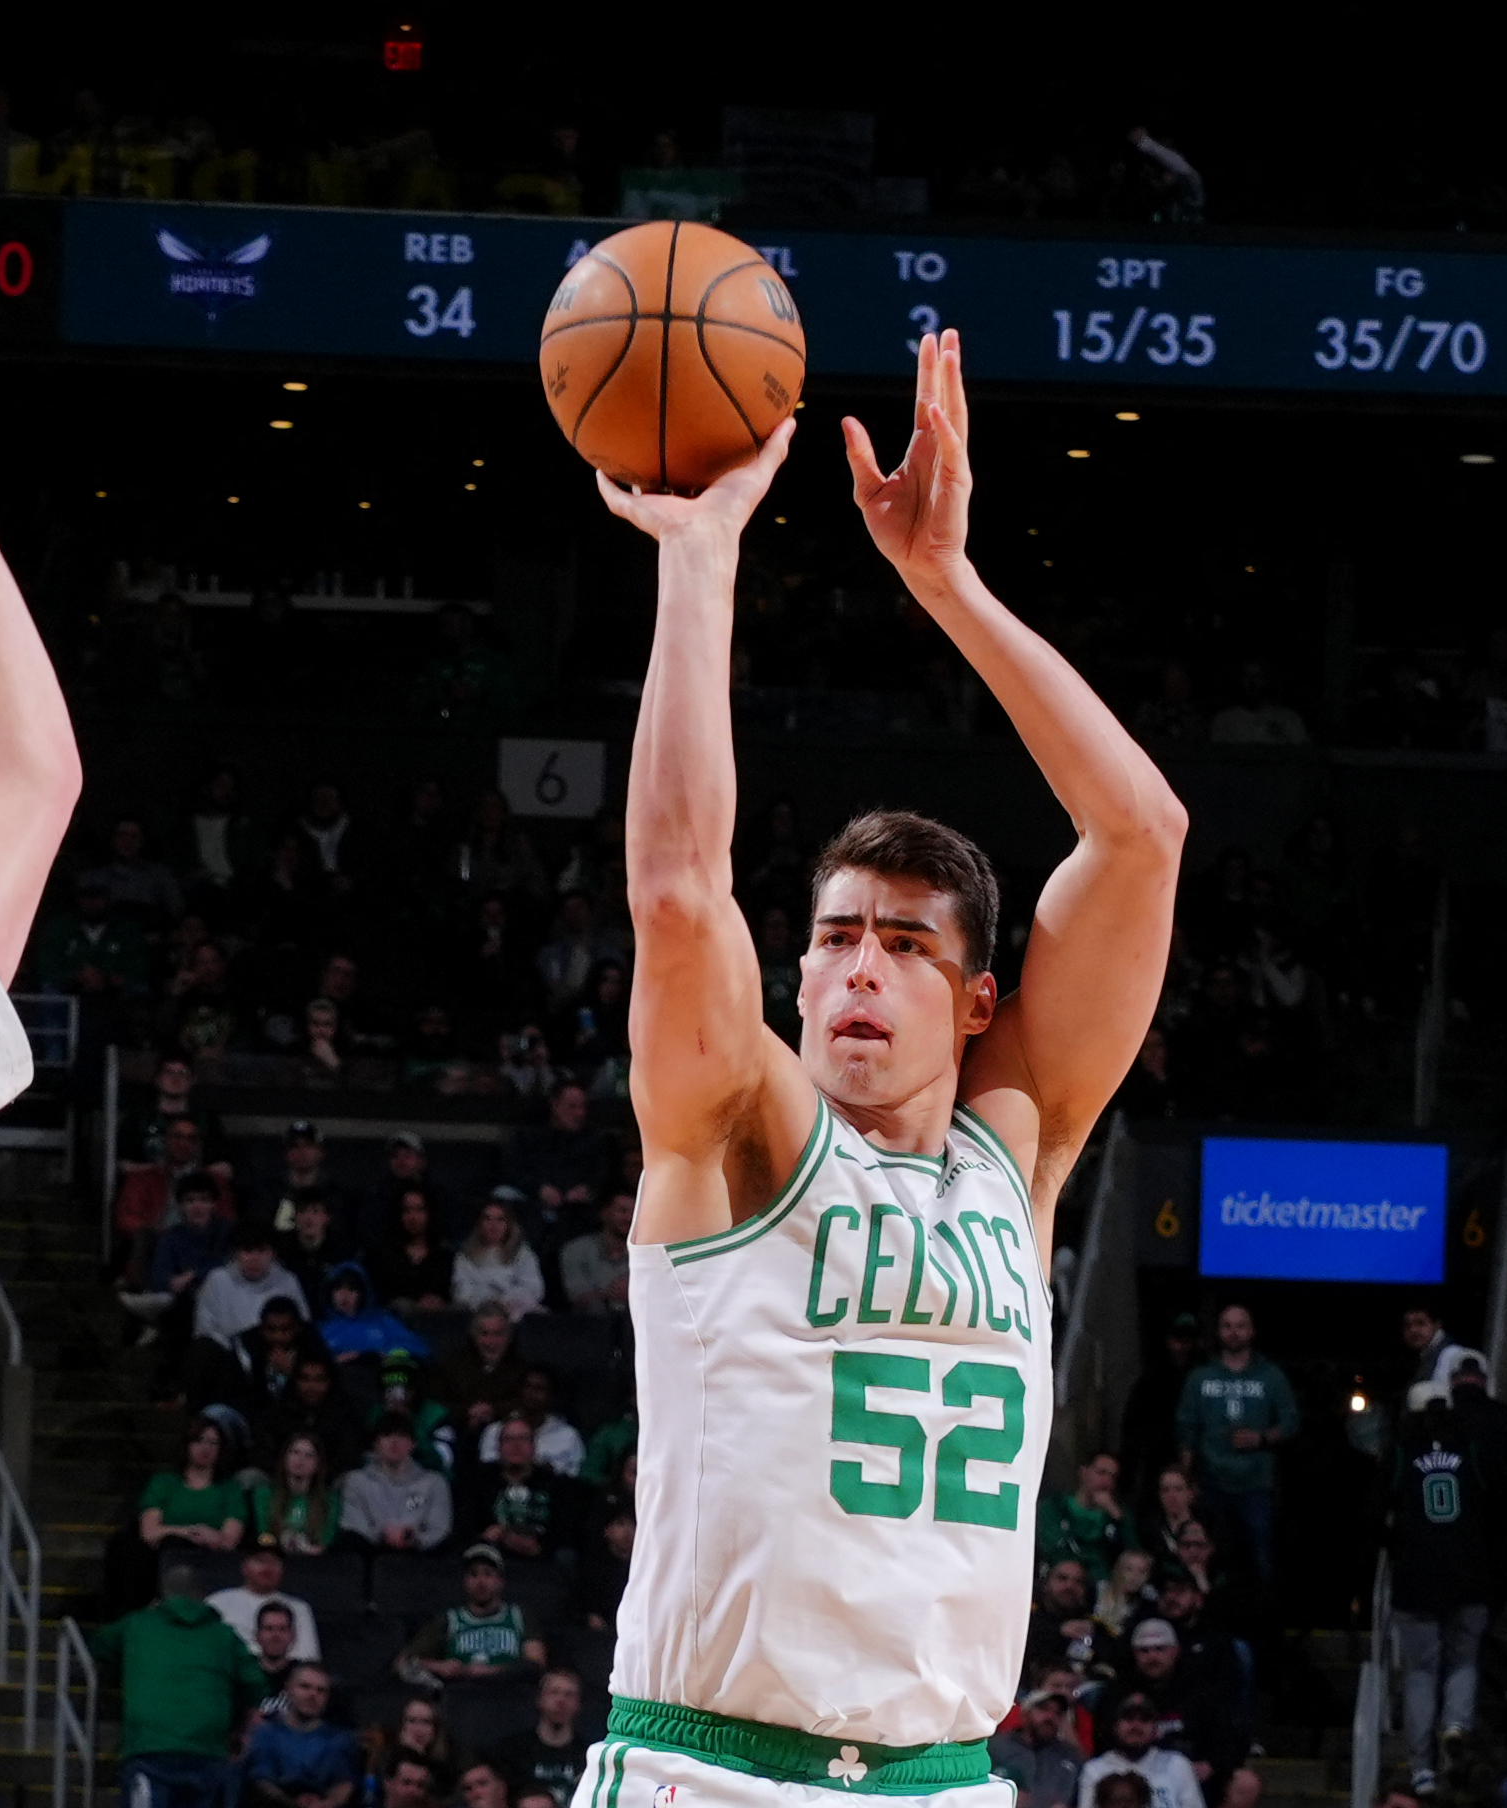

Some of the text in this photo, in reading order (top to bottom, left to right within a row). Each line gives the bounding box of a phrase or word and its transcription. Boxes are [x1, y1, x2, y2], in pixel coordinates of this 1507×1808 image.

[405, 233, 472, 264] REB
[895, 252, 948, 283] TO
[170, 273, 255, 298] HORNETS
[1097, 257, 1167, 291] 3PT
[1375, 267, 1426, 299] FG
[405, 285, 474, 338] 34
[906, 305, 941, 356] 3
[1053, 306, 1217, 368] 15/35
[1314, 316, 1487, 374] 35/70
[534, 750, 569, 806] 6
[1155, 1199, 1179, 1239] 6
[1220, 1192, 1427, 1232] ticketmaster
[1464, 1209, 1486, 1251] 6
[806, 1203, 1032, 1343] CELTICS
[830, 1351, 1027, 1531] 52
